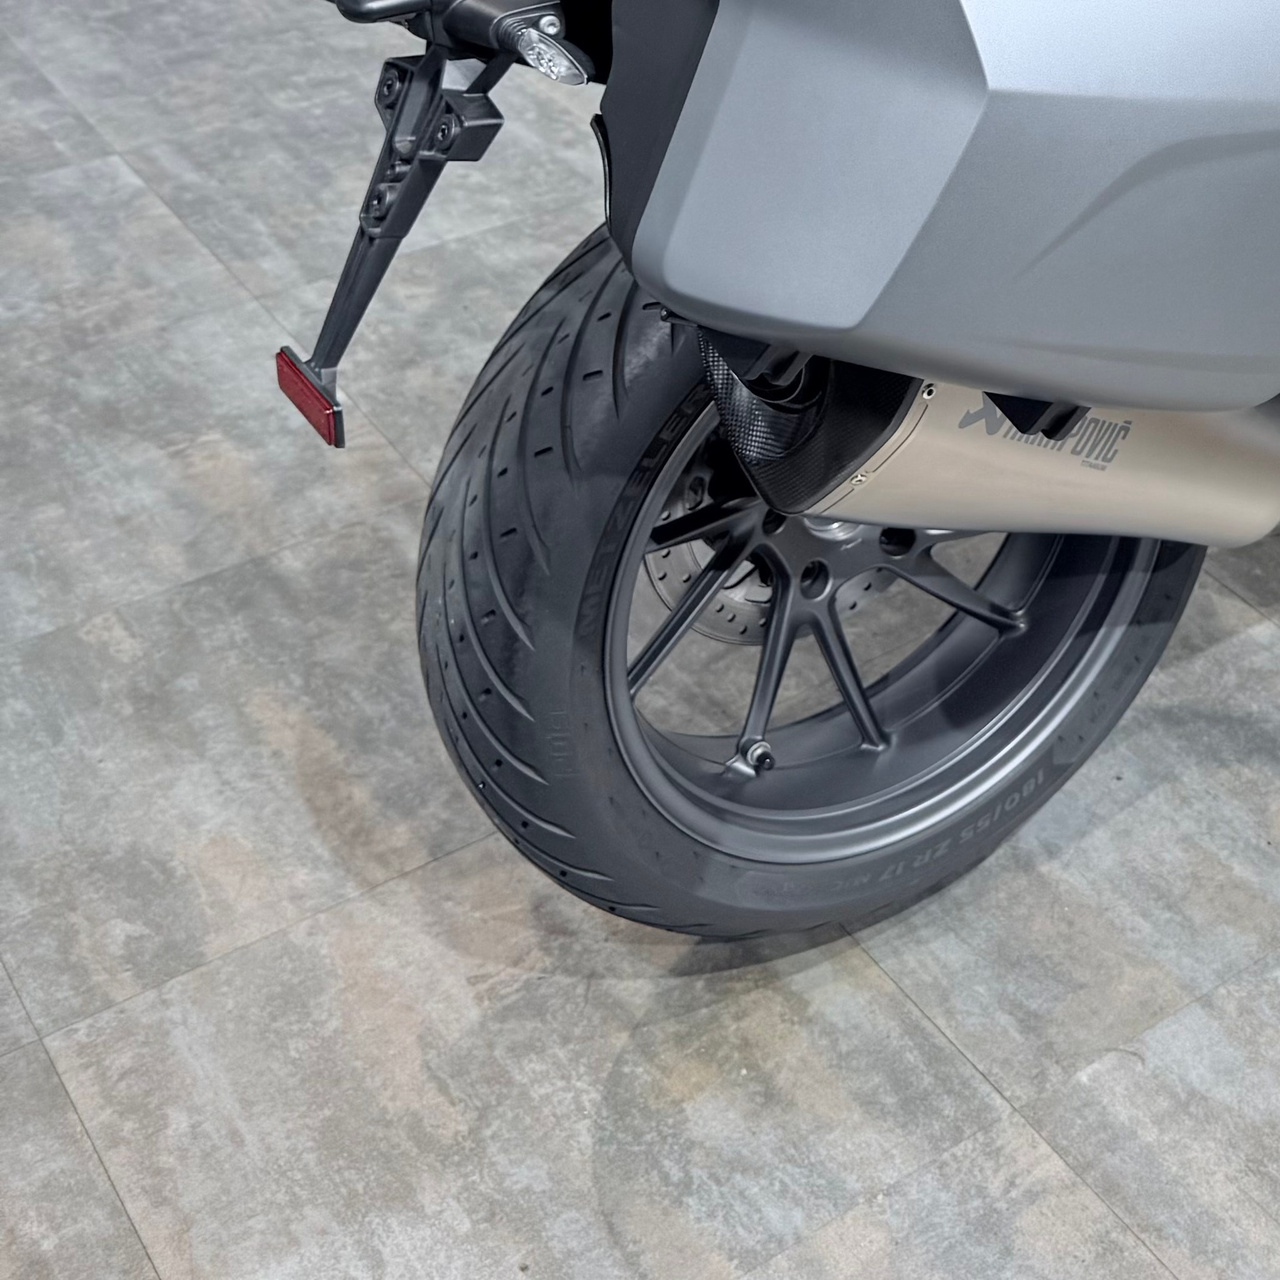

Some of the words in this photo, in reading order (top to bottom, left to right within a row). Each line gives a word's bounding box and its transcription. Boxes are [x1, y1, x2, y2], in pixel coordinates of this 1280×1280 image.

[959, 768, 1045, 844] 180/55
[912, 837, 954, 868] ZR
[878, 860, 906, 883] 17
